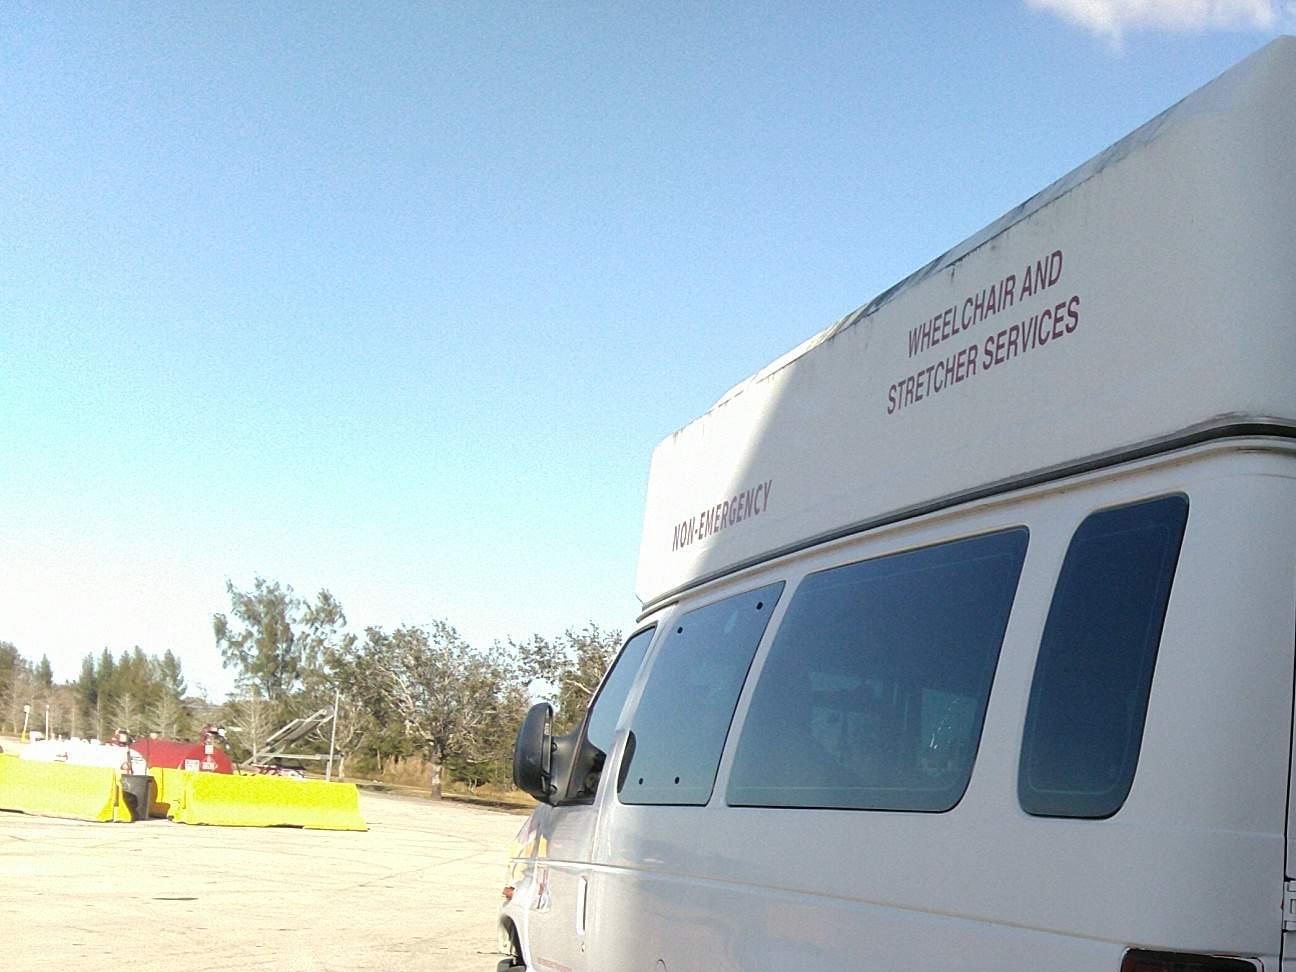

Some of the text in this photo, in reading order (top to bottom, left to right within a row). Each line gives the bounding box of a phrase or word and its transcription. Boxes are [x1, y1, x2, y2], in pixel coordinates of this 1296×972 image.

[887, 295, 1081, 416] STRETCHER SERVICES
[907, 249, 1064, 358] WHEELCHAIR AND
[672, 480, 772, 552] NON-EMERGENCY
